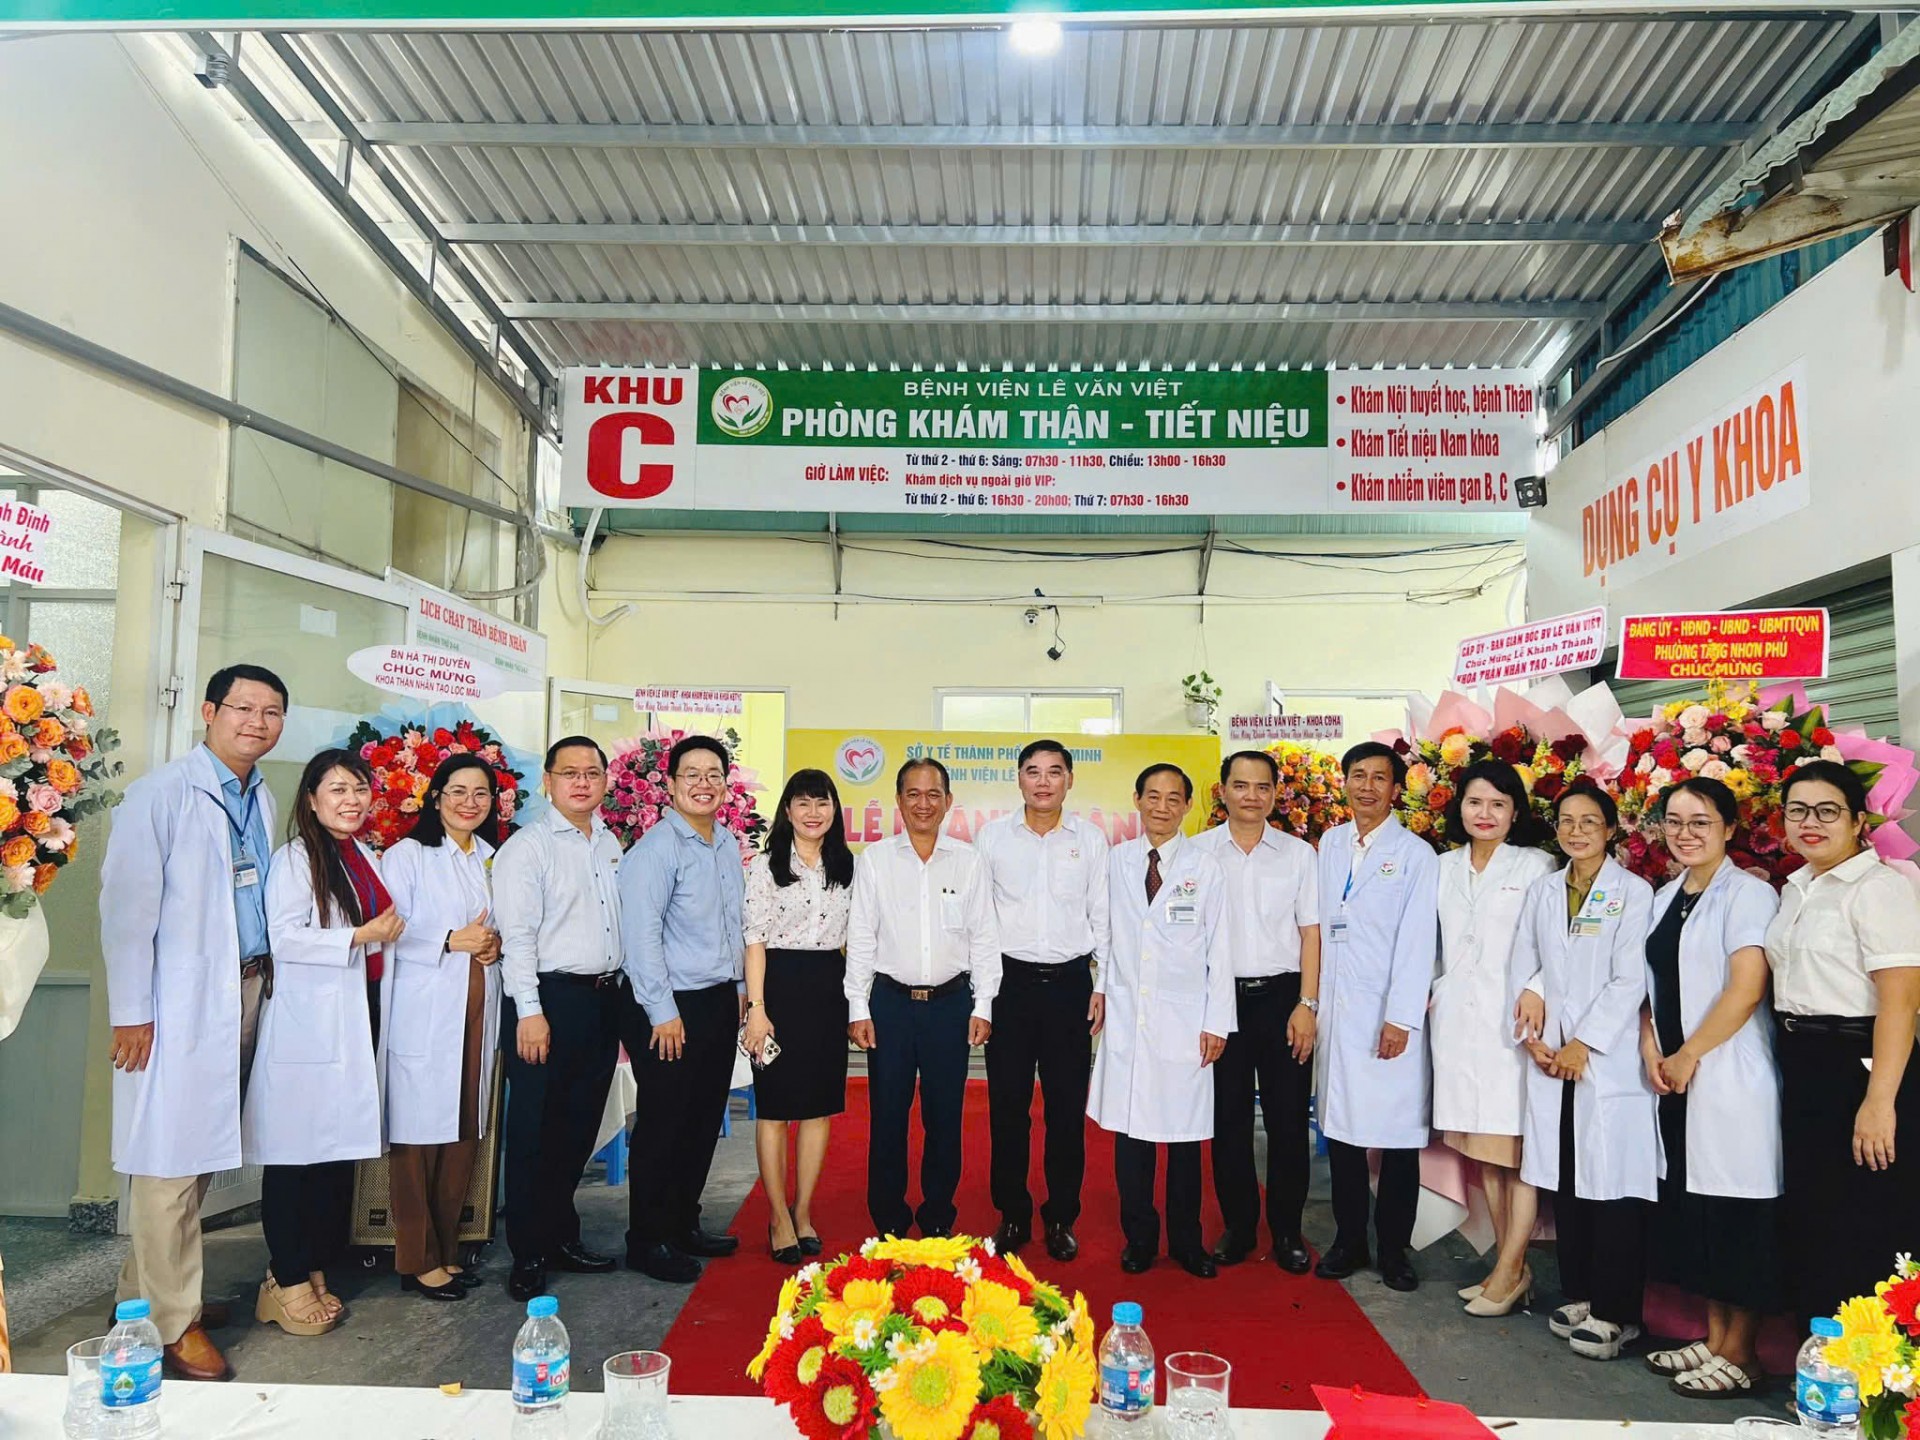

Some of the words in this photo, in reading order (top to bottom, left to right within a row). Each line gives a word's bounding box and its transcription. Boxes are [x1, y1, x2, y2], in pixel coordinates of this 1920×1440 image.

[584, 376, 683, 404] KHU
[904, 378, 968, 398] BỆNH
[976, 378, 1030, 399] VIỆN
[1038, 378, 1066, 396] LÊ
[1074, 378, 1122, 396] VĂN
[1130, 378, 1183, 398] VIỆT
[1351, 385, 1384, 414] Khám
[1388, 384, 1406, 420] Nội
[1410, 380, 1442, 416] huyết
[1445, 385, 1470, 419] học,
[1473, 384, 1502, 419] bệnh
[1504, 384, 1532, 419] Thận
[782, 402, 897, 438] PHÒNG
[908, 404, 1008, 438] KHÁM
[1020, 404, 1108, 446] THẬN
[1145, 400, 1216, 438] TIẾT
[1228, 402, 1310, 444] NIỆU
[1351, 429, 1384, 457] Khám
[1388, 424, 1408, 457] Tiết
[1412, 428, 1437, 463] niệu
[1440, 428, 1467, 457] Nam
[1471, 428, 1499, 457] khoa
[586, 412, 674, 499] C
[906, 454, 920, 466] Từ
[922, 454, 938, 466] thứ
[941, 454, 948, 466] 2
[959, 454, 976, 466] thứ
[979, 455, 988, 466] 6:
[992, 454, 1022, 468] Sáng:
[1025, 455, 1058, 467] 07h30
[1070, 455, 1106, 468] 11h30,
[1109, 453, 1144, 467] Chiều:
[1148, 455, 1180, 467] 13h00
[1192, 455, 1226, 467] 16h30
[805, 463, 826, 481] GIỜ
[829, 464, 855, 481] LÀM
[859, 464, 889, 485] VIỆC:
[906, 474, 936, 486] Khám
[939, 474, 962, 488] dịch
[966, 476, 978, 488] vụ
[981, 475, 1011, 488] ngoài
[1014, 474, 1031, 488] giờ
[1035, 475, 1056, 487] VIP:
[1582, 477, 1640, 587] DỤNG
[1646, 450, 1680, 556] CỤ
[1686, 436, 1703, 524] Y
[1712, 380, 1802, 514] KHOA
[1351, 472, 1384, 501] Khám
[1388, 468, 1424, 501] nhiễm
[1428, 472, 1456, 501] viêm
[1460, 478, 1481, 504] gan
[1485, 472, 1496, 504] B,
[1500, 472, 1508, 501] C
[904, 493, 920, 505] Từ
[922, 493, 938, 505] thứ
[940, 494, 947, 505] 2
[958, 493, 975, 505] thứ
[978, 494, 988, 506] 6:
[992, 494, 1024, 506] 16h30
[1074, 494, 1094, 506] Thứ
[1096, 494, 1107, 506] 7:
[1110, 494, 1144, 506] 07h30
[1155, 494, 1188, 506] 16h30
[16, 506, 50, 534] Định
[1, 554, 44, 582] Máu
[420, 598, 442, 620] LỊCH
[442, 607, 466, 630] CHẠY
[466, 617, 488, 638] THẬN
[488, 624, 508, 646] BỆNH
[508, 633, 528, 653] NHÂN
[1629, 617, 1656, 638] ĐẢNG
[1658, 617, 1672, 636] ỦY
[1680, 620, 1711, 635] HĐND
[1720, 618, 1750, 634] UBND
[1760, 615, 1820, 638] UBMTTQVN
[1490, 640, 1504, 651] BAN
[1540, 628, 1551, 640] BV
[1527, 642, 1558, 656] Khánh
[1562, 634, 1594, 650] Thành
[1654, 640, 1698, 660] PHƯỜNG
[1730, 641, 1762, 658] NHƠN
[1764, 636, 1788, 658] PHÚ
[390, 650, 404, 660] BN
[406, 651, 419, 662] HÀ
[422, 654, 437, 667] THỊ
[438, 656, 470, 670] DUYÊN
[1670, 660, 1712, 676] CHÚC
[1714, 659, 1763, 676] MỪNG
[375, 674, 394, 686] KHOA
[396, 677, 414, 689] THẬN
[416, 680, 434, 691] NHÂN
[383, 662, 425, 676] CHÚC
[430, 669, 476, 684] MỪNG
[1456, 672, 1477, 684] KHOA
[1232, 714, 1248, 727] BỆNH
[1250, 714, 1263, 728] VIỆN
[1265, 714, 1272, 726] LÊ
[1274, 714, 1287, 726] VĂN
[1307, 716, 1322, 726] KHOA
[906, 743, 923, 759] SỞ
[926, 746, 935, 759] Y
[938, 743, 951, 760] TẾ
[954, 744, 994, 760] THÀNH
[1070, 749, 1101, 762] MINH
[972, 766, 998, 784] VIỆN
[1002, 767, 1015, 782] LÊ
[844, 800, 883, 842] LỄ
